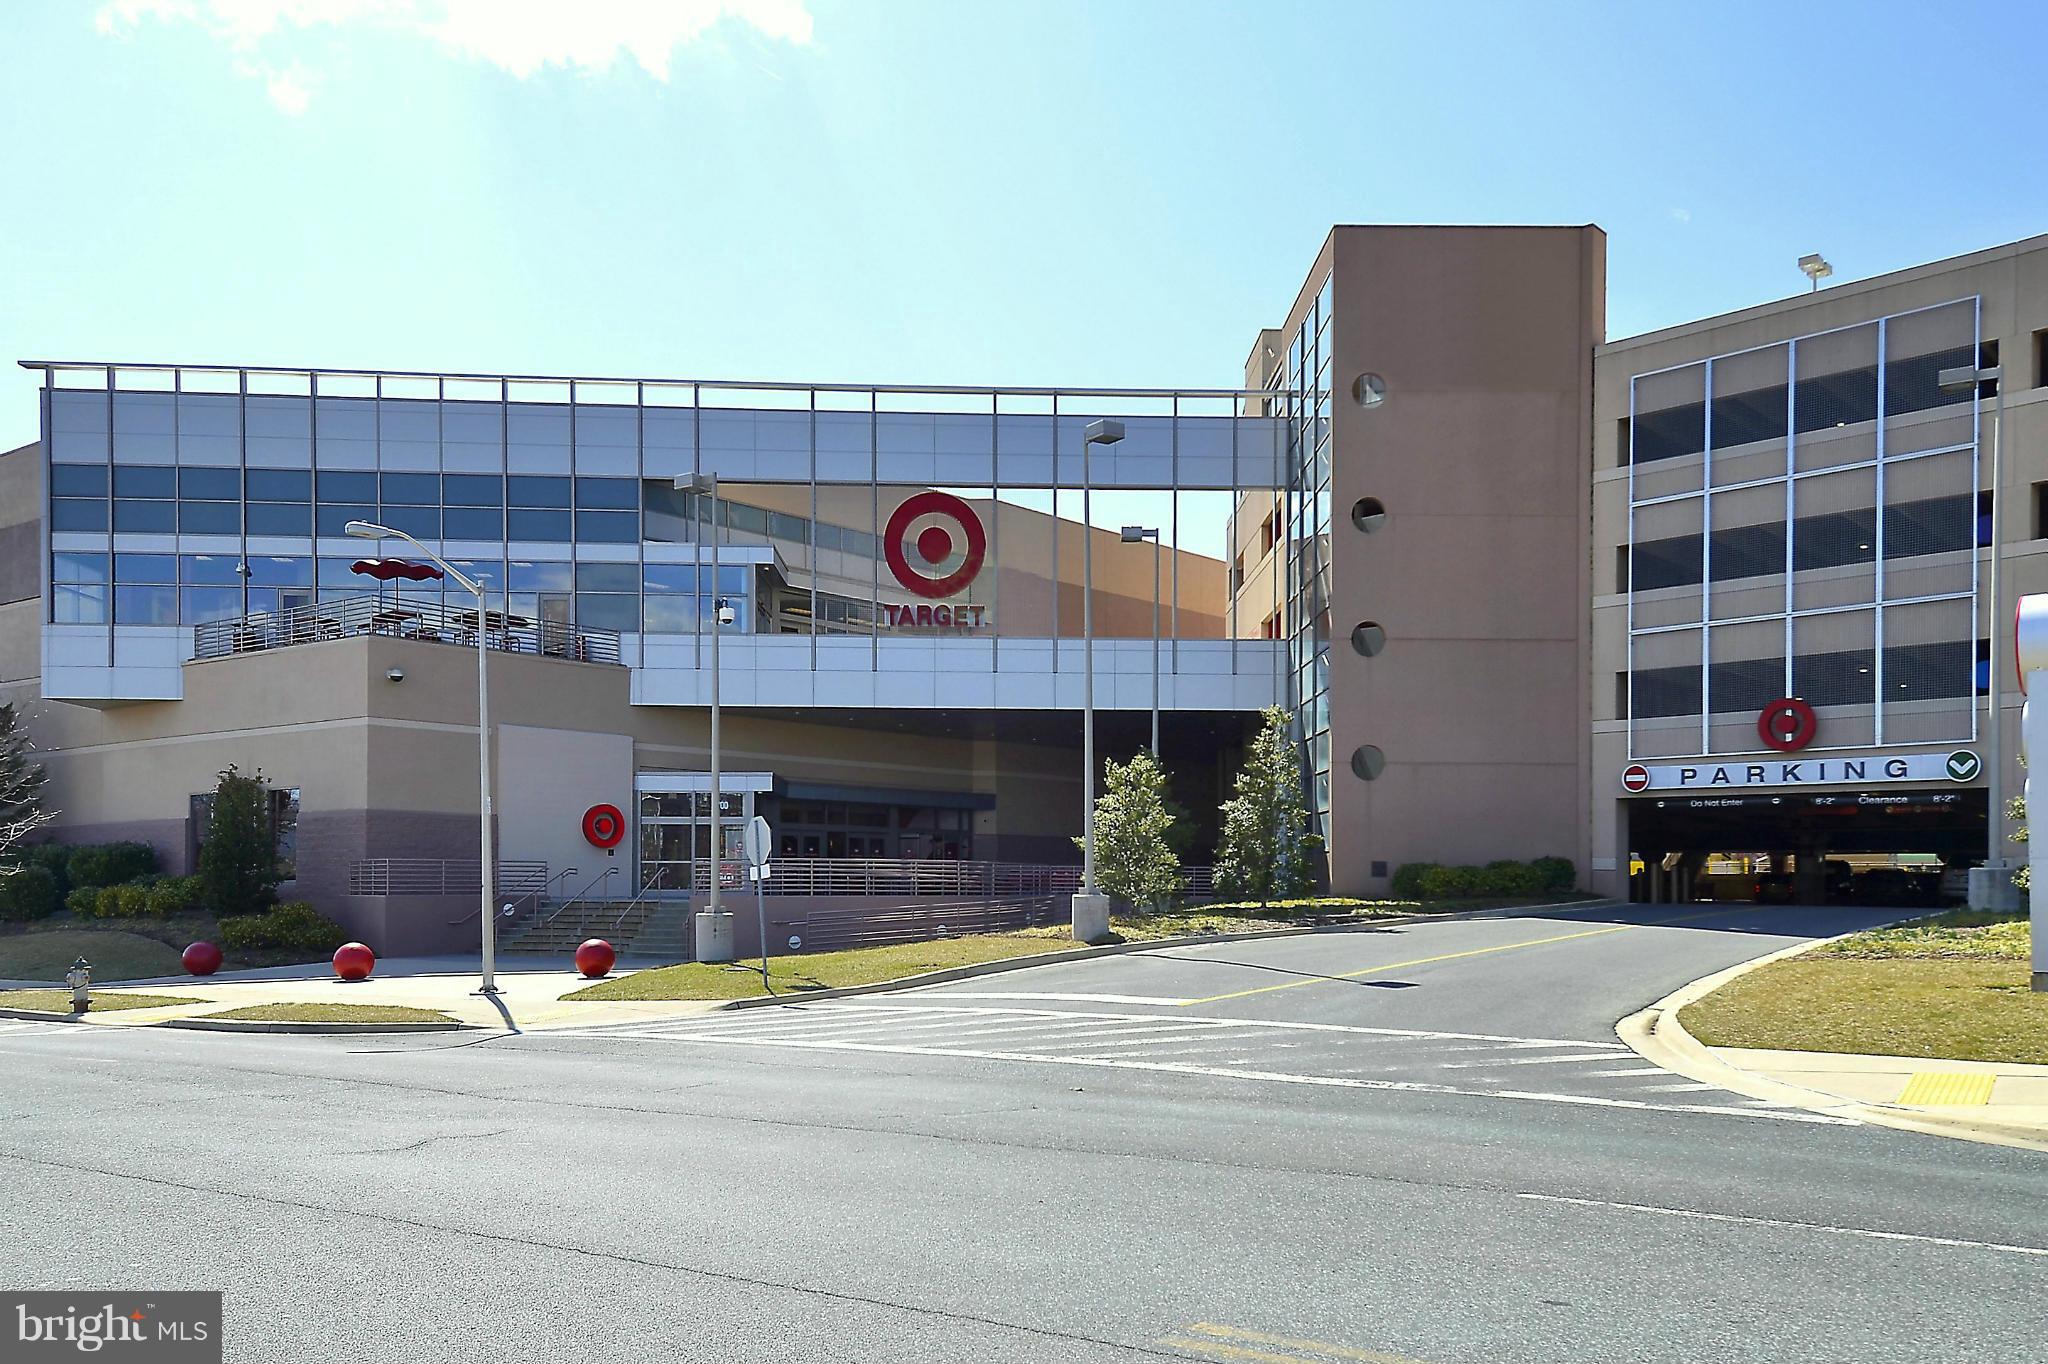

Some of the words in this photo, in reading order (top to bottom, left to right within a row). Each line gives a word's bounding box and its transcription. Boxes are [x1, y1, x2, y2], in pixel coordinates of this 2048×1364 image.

[883, 603, 986, 627] TARGET
[1680, 759, 1908, 785] PARKING
[1704, 799, 1720, 807] Not
[1721, 798, 1744, 806] Enter
[1858, 796, 1908, 804] Clearance
